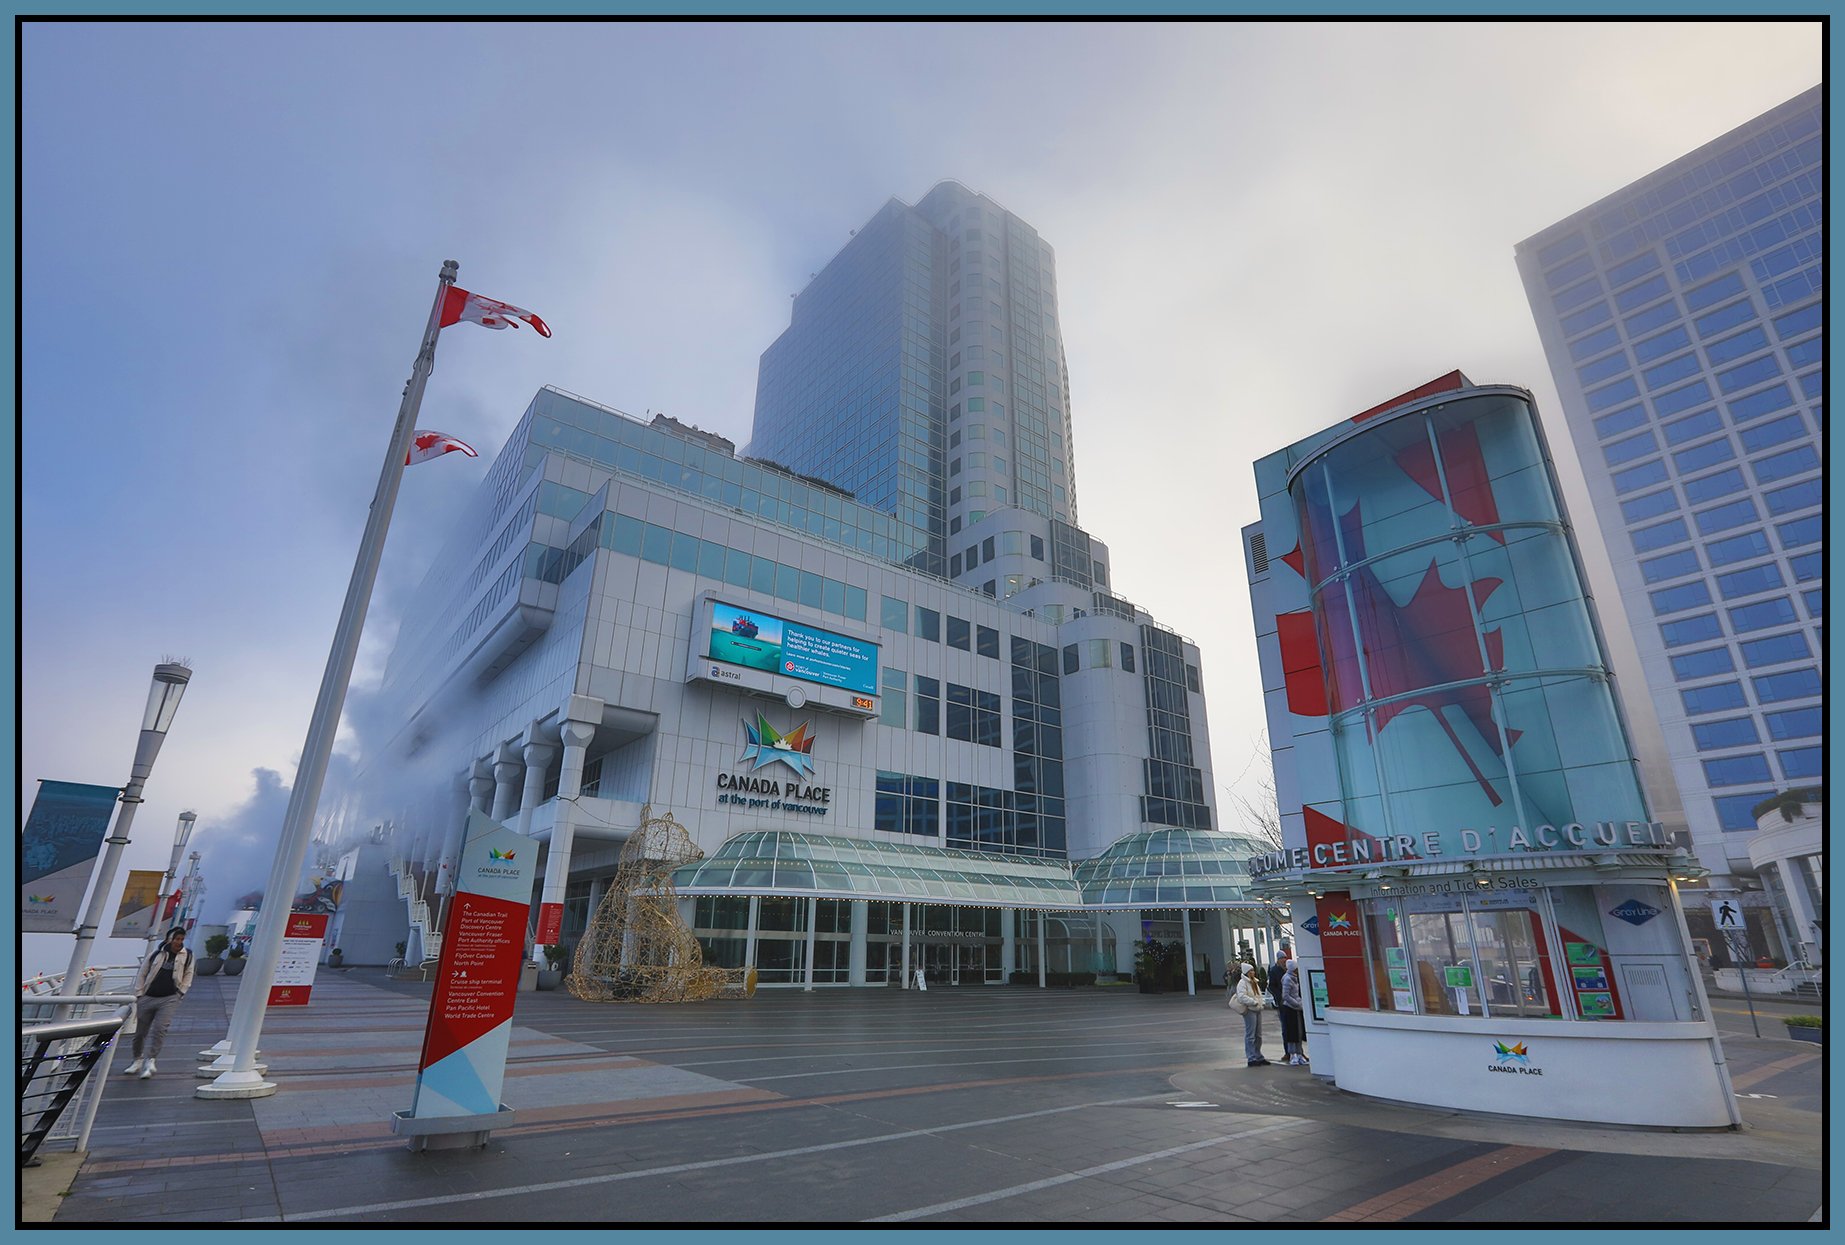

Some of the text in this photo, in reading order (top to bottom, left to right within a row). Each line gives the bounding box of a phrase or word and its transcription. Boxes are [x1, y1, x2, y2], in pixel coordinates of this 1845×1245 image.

[787, 636, 807, 646] helping
[831, 646, 849, 656] quieter
[787, 642, 810, 652] healthier
[788, 630, 804, 638] Thank
[832, 640, 852, 651] partners
[721, 670, 741, 680] astral
[856, 697, 873, 709] 9:41
[718, 773, 831, 803] CANADA PLACE
[718, 794, 828, 815] at the port of vancouver
[1314, 832, 1442, 865] CENTRE
[1371, 876, 1538, 897] Information and Ticket Sales
[1488, 1064, 1543, 1075] CANADA PLACE
